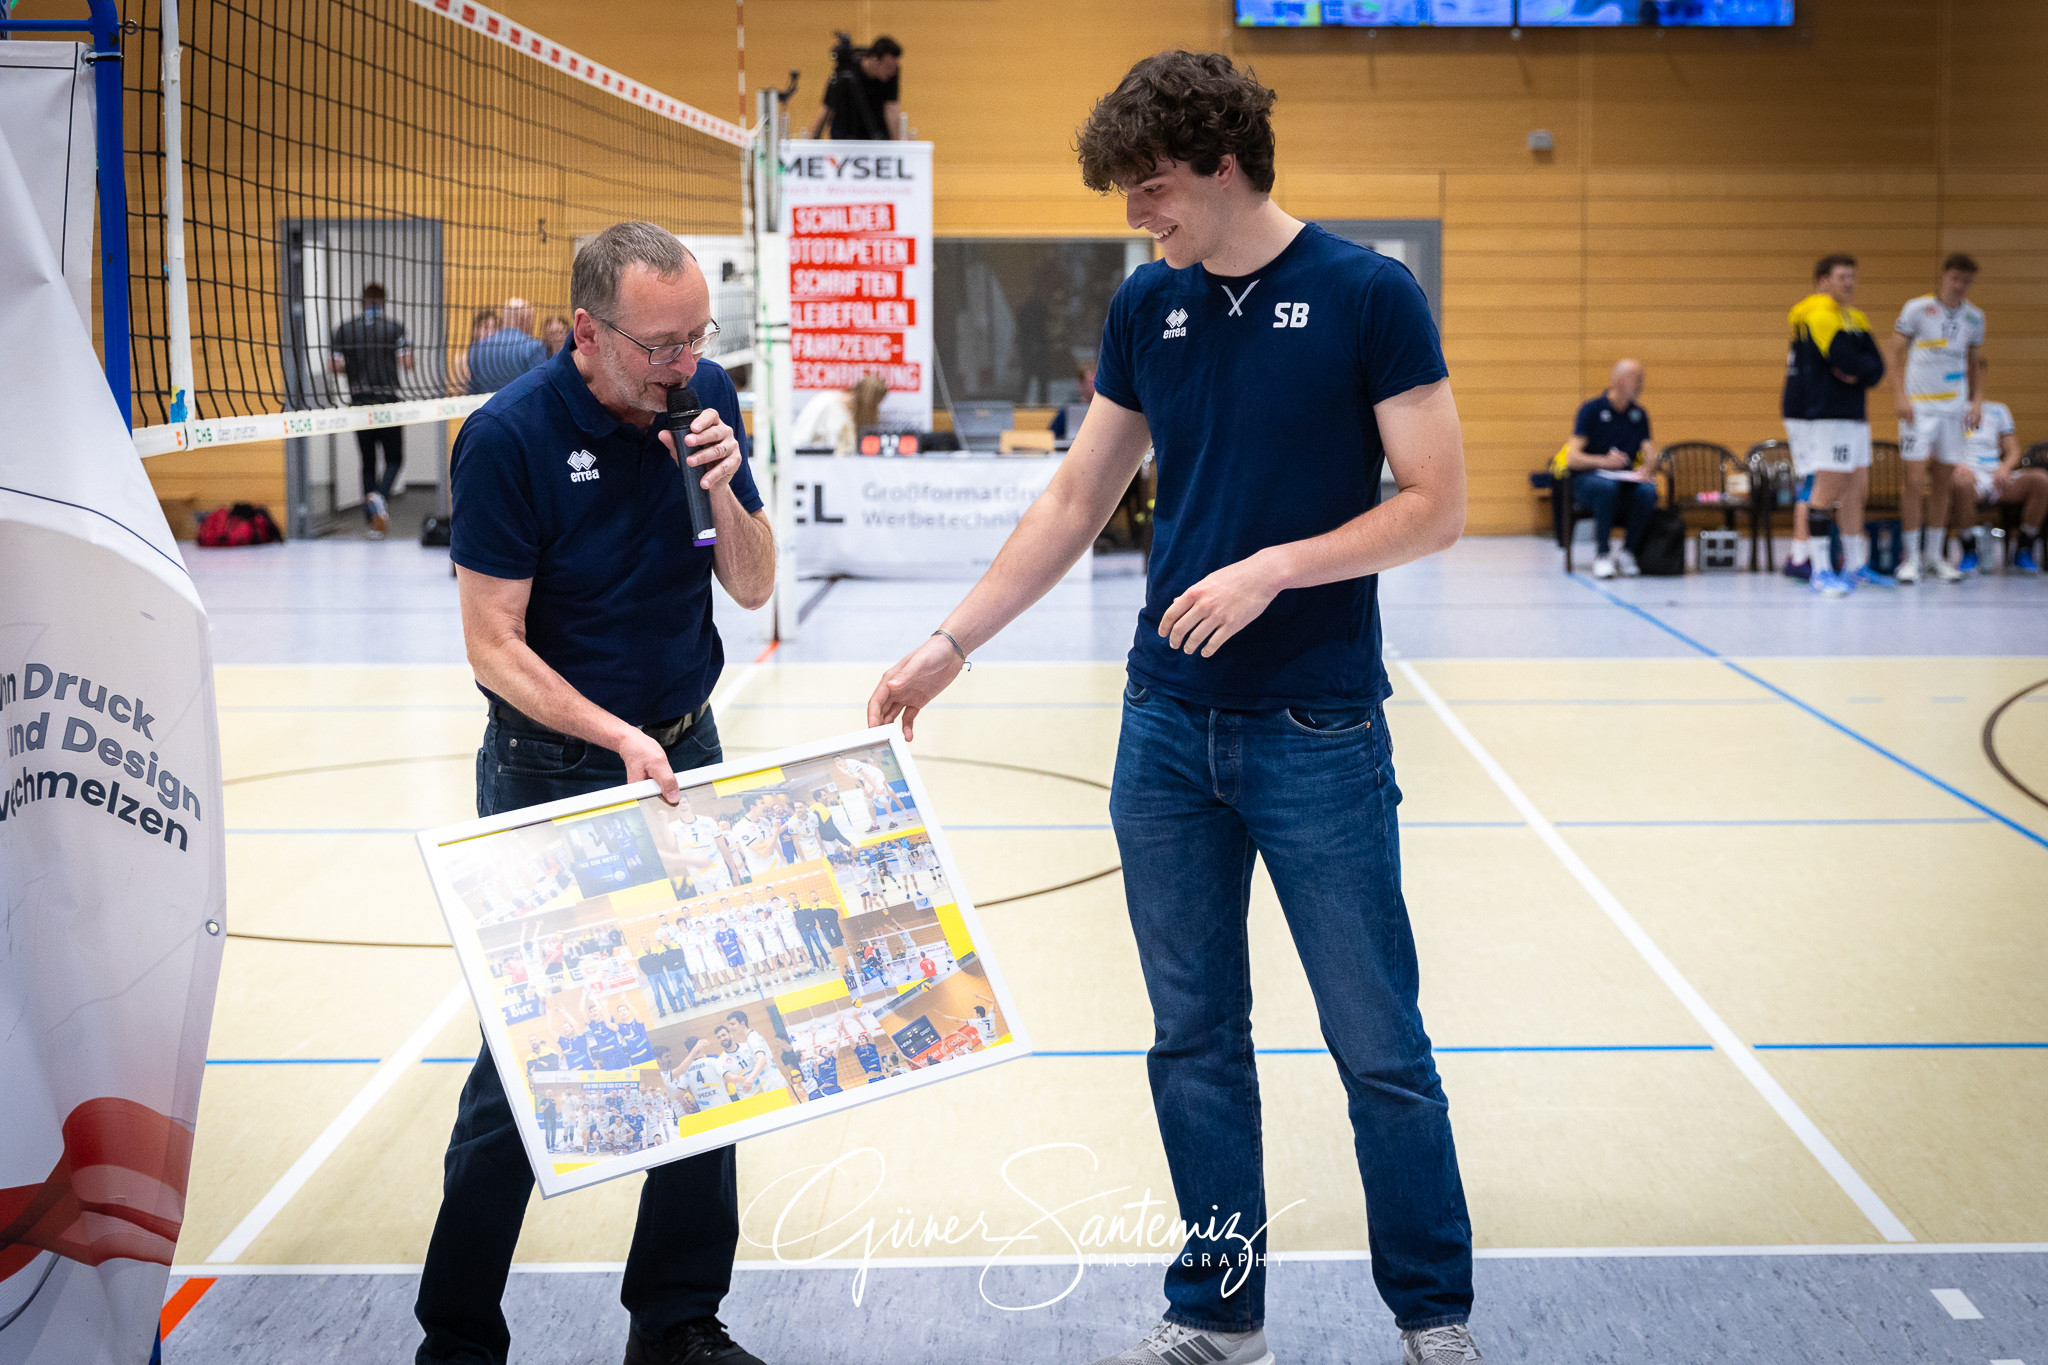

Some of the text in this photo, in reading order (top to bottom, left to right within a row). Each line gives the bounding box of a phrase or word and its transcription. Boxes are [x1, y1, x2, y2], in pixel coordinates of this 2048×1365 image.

[778, 156, 914, 179] MEYSEL
[795, 206, 891, 234] SCHILDER
[790, 237, 909, 264] OTOTAPETEN
[793, 269, 897, 298] SCHRIFTEN
[791, 301, 908, 328] LEBEFOLIEN
[1273, 302, 1310, 328] SB
[793, 362, 919, 389] ESCHRIFTUNG
[23, 663, 156, 742] Druck
[61, 716, 201, 822] Design
[509, 1002, 534, 1018] Bier
[696, 1070, 705, 1083] 4
[738, 1059, 748, 1070] 11
